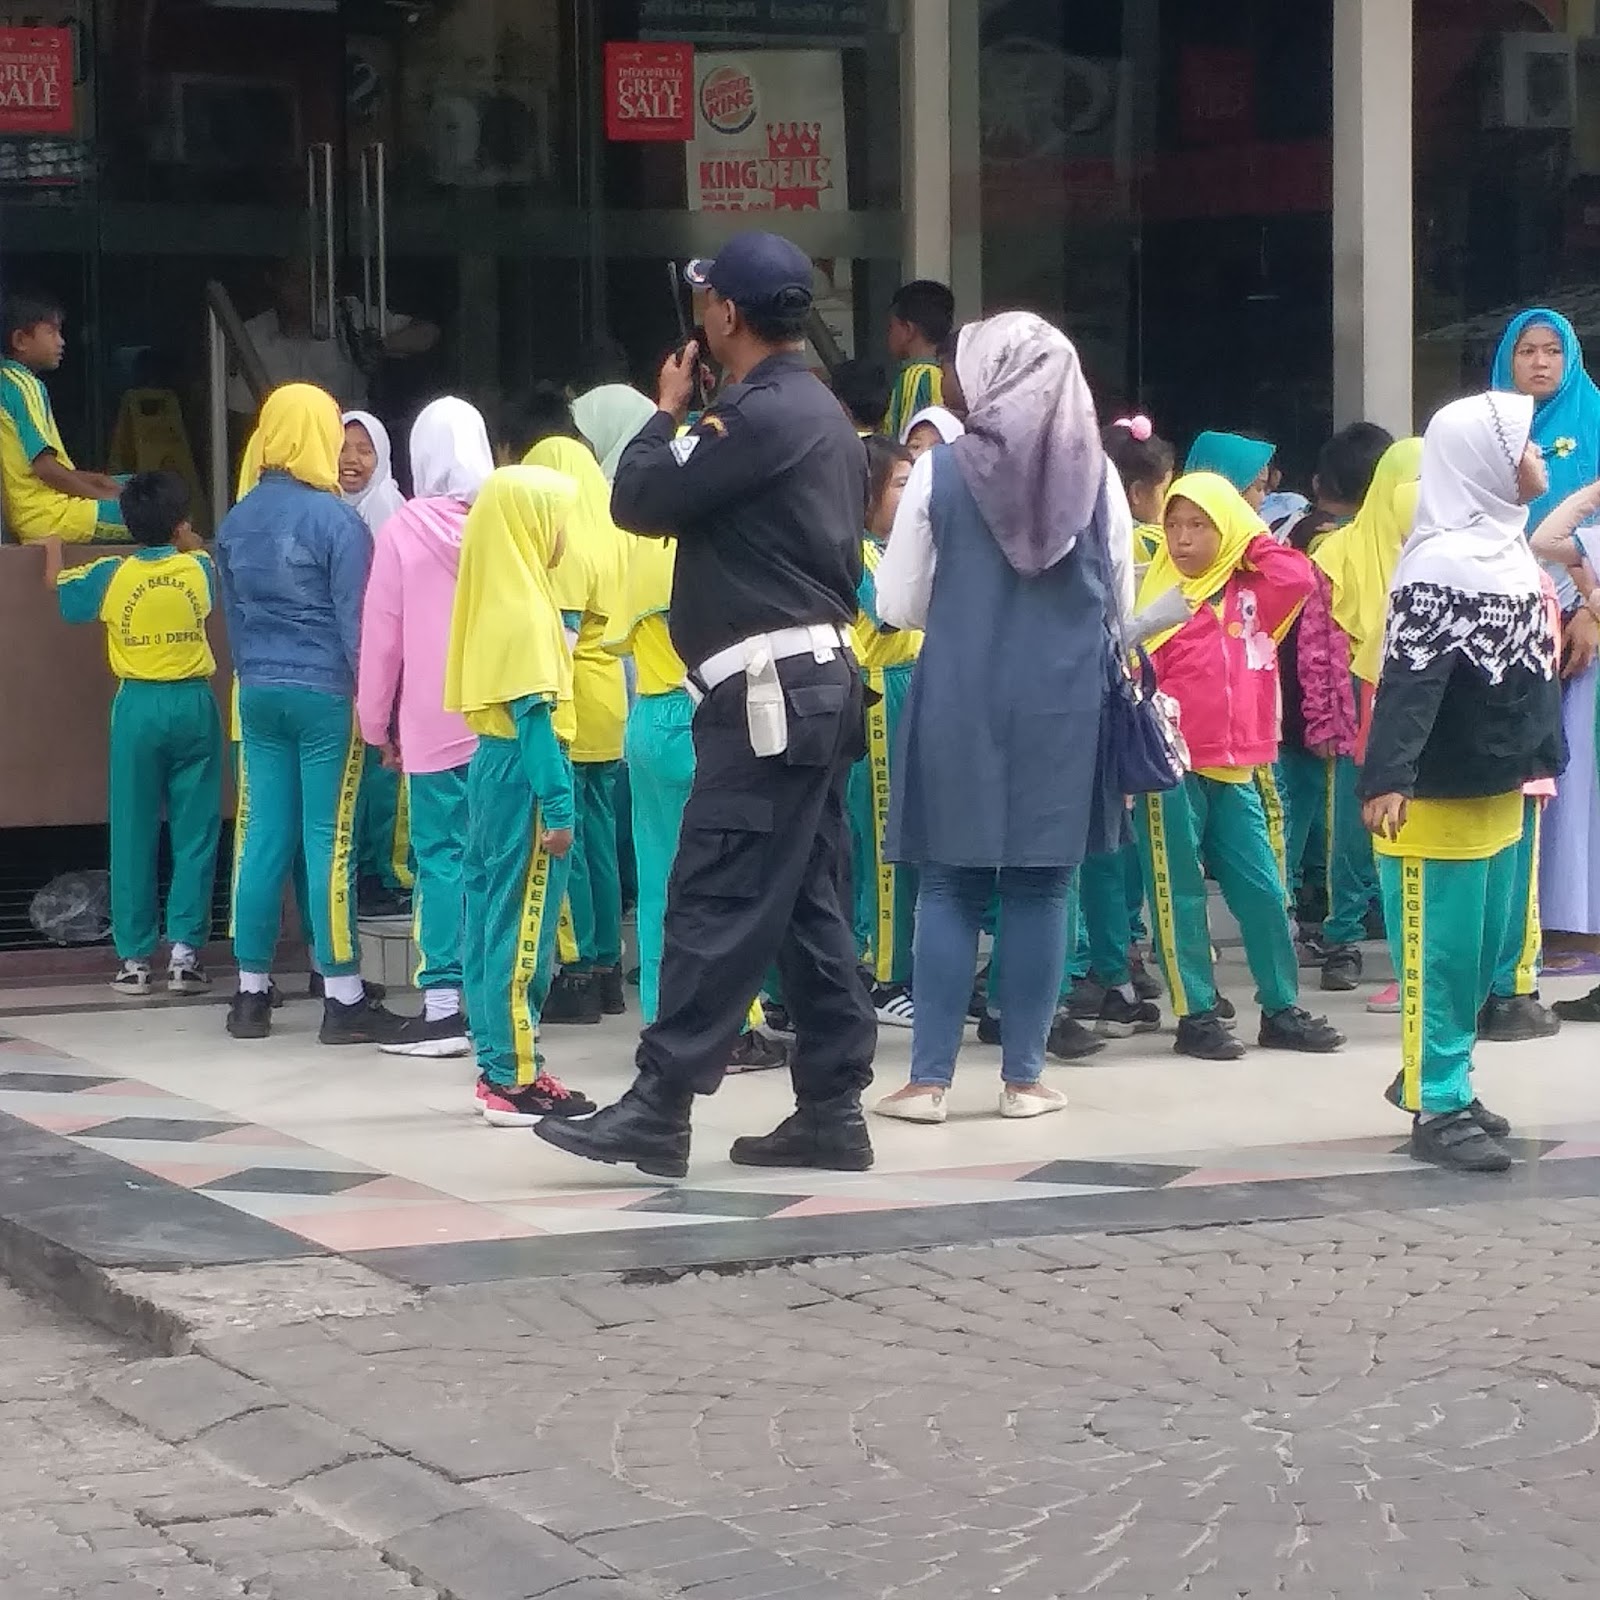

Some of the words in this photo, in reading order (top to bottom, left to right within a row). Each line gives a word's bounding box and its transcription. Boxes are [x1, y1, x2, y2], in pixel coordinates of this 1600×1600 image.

[617, 77, 682, 95] GREAT
[617, 93, 683, 119] SALE
[707, 89, 755, 121] KING
[700, 161, 757, 189] KING
[758, 159, 831, 188] DEALS
[1151, 797, 1164, 865] EGERI
[1406, 865, 1420, 959] NEGERI
[1406, 968, 1419, 1033] BEJI
[517, 1019, 530, 1031] 3
